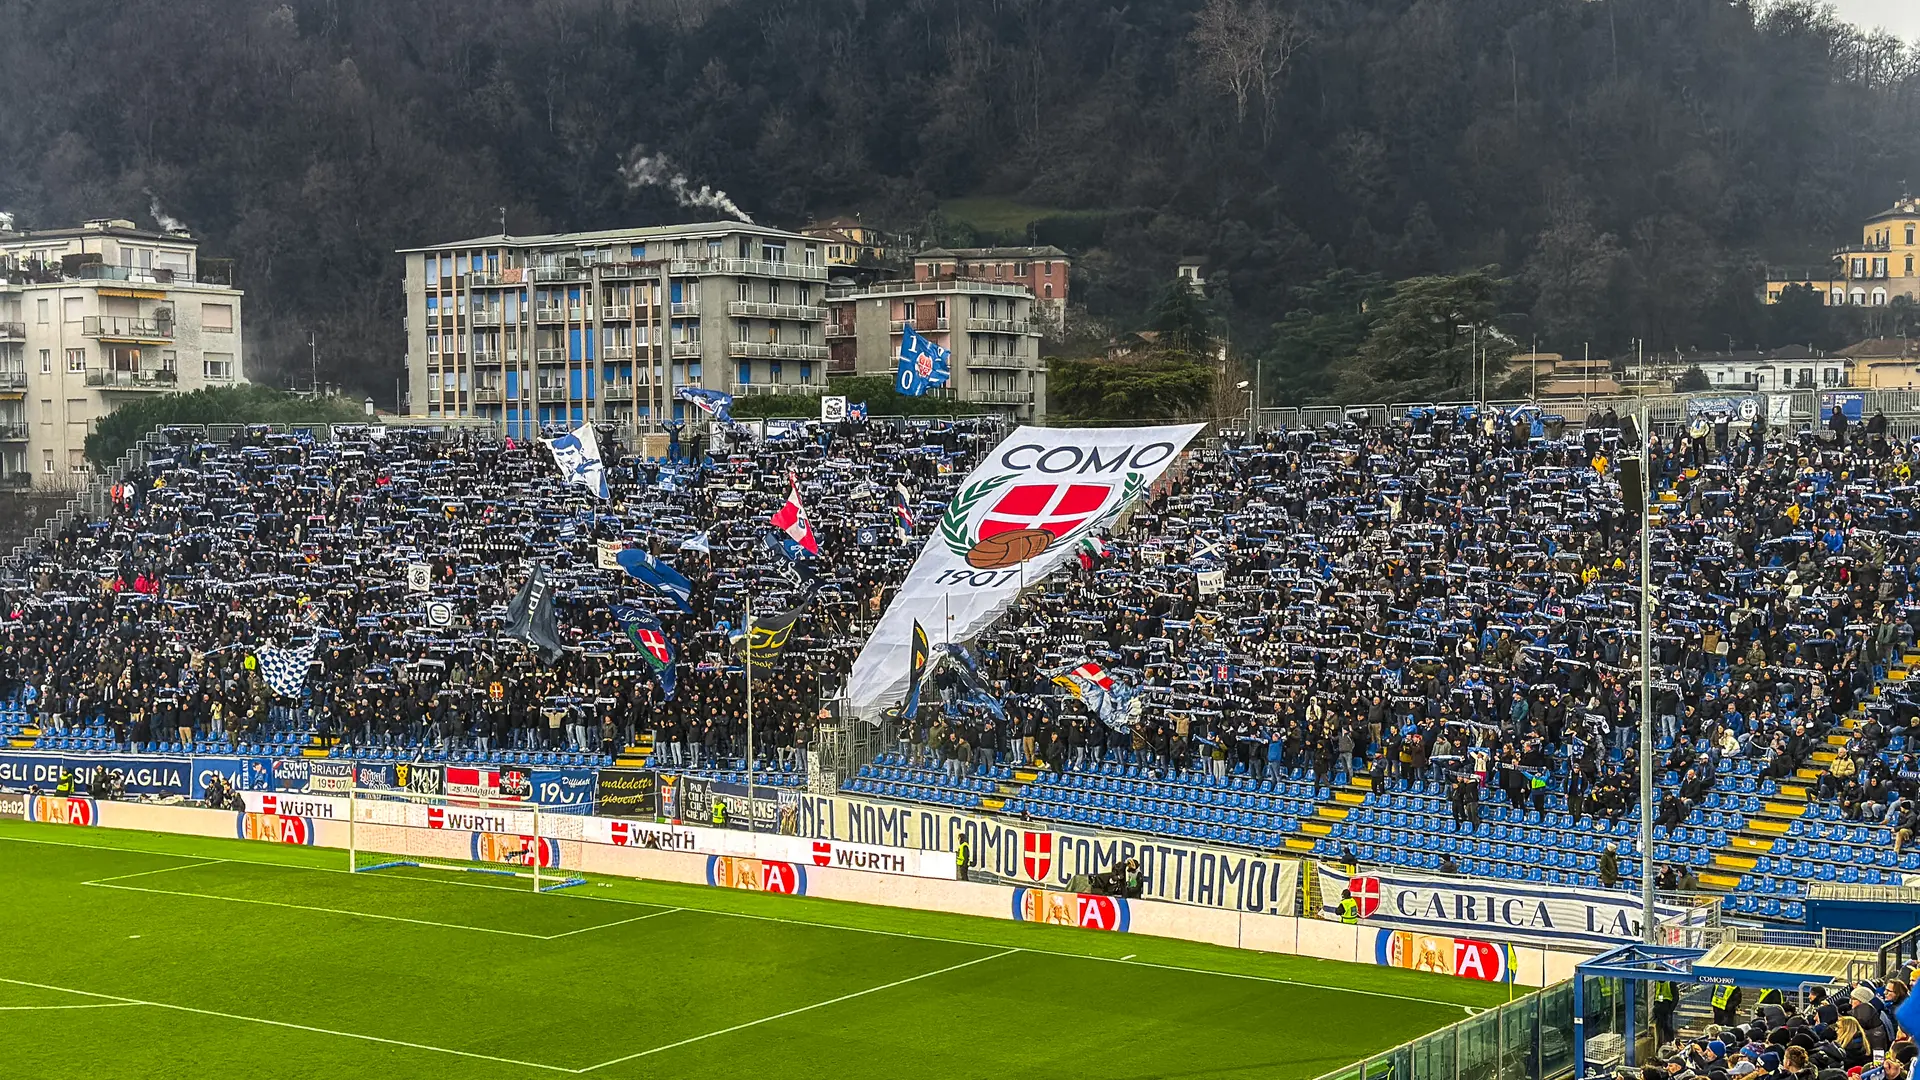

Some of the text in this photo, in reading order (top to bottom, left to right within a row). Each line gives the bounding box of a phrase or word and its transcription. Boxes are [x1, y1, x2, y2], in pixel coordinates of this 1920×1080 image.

[1000, 442, 1175, 475] COMO
[934, 569, 1020, 588] 1907
[274, 769, 308, 780] MCMVII
[283, 762, 308, 771] COMO
[311, 763, 352, 776] BRIANZA
[462, 786, 497, 797] Maggio
[280, 801, 333, 818] WÜRTH
[802, 793, 843, 841] NEL
[849, 801, 912, 848] NOME
[920, 811, 941, 854] DI
[949, 816, 1018, 878] COMO
[836, 848, 905, 872] WÜRTH
[1397, 889, 1555, 929] CARICA
